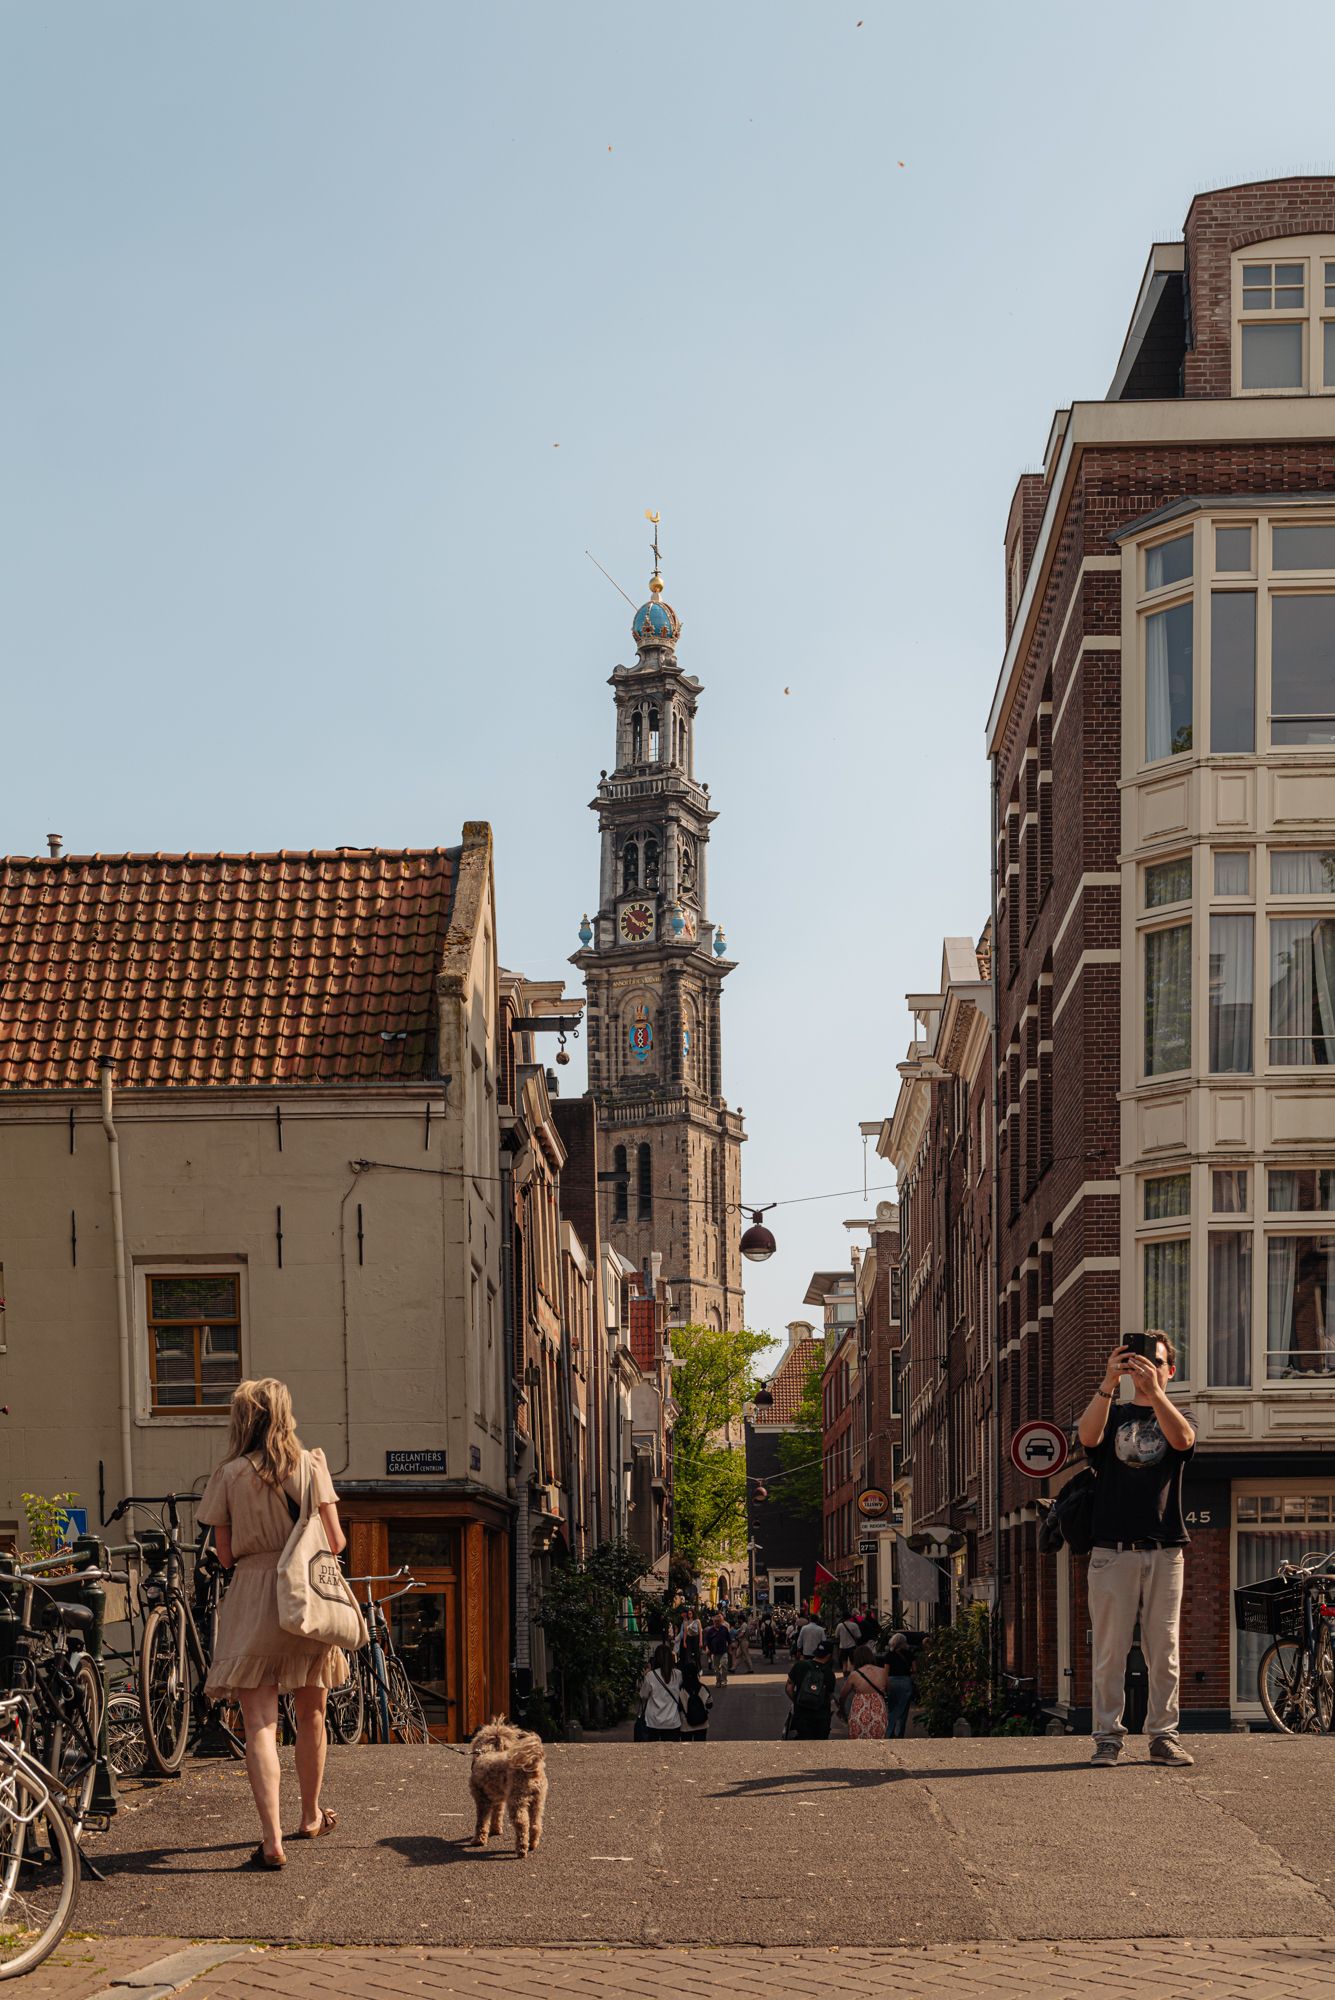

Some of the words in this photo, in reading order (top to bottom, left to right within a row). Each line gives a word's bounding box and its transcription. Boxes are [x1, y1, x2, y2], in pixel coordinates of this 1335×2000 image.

[390, 1452, 442, 1462] EGELANTIERS
[388, 1463, 420, 1472] GRACHT
[1185, 1511, 1211, 1524] 45
